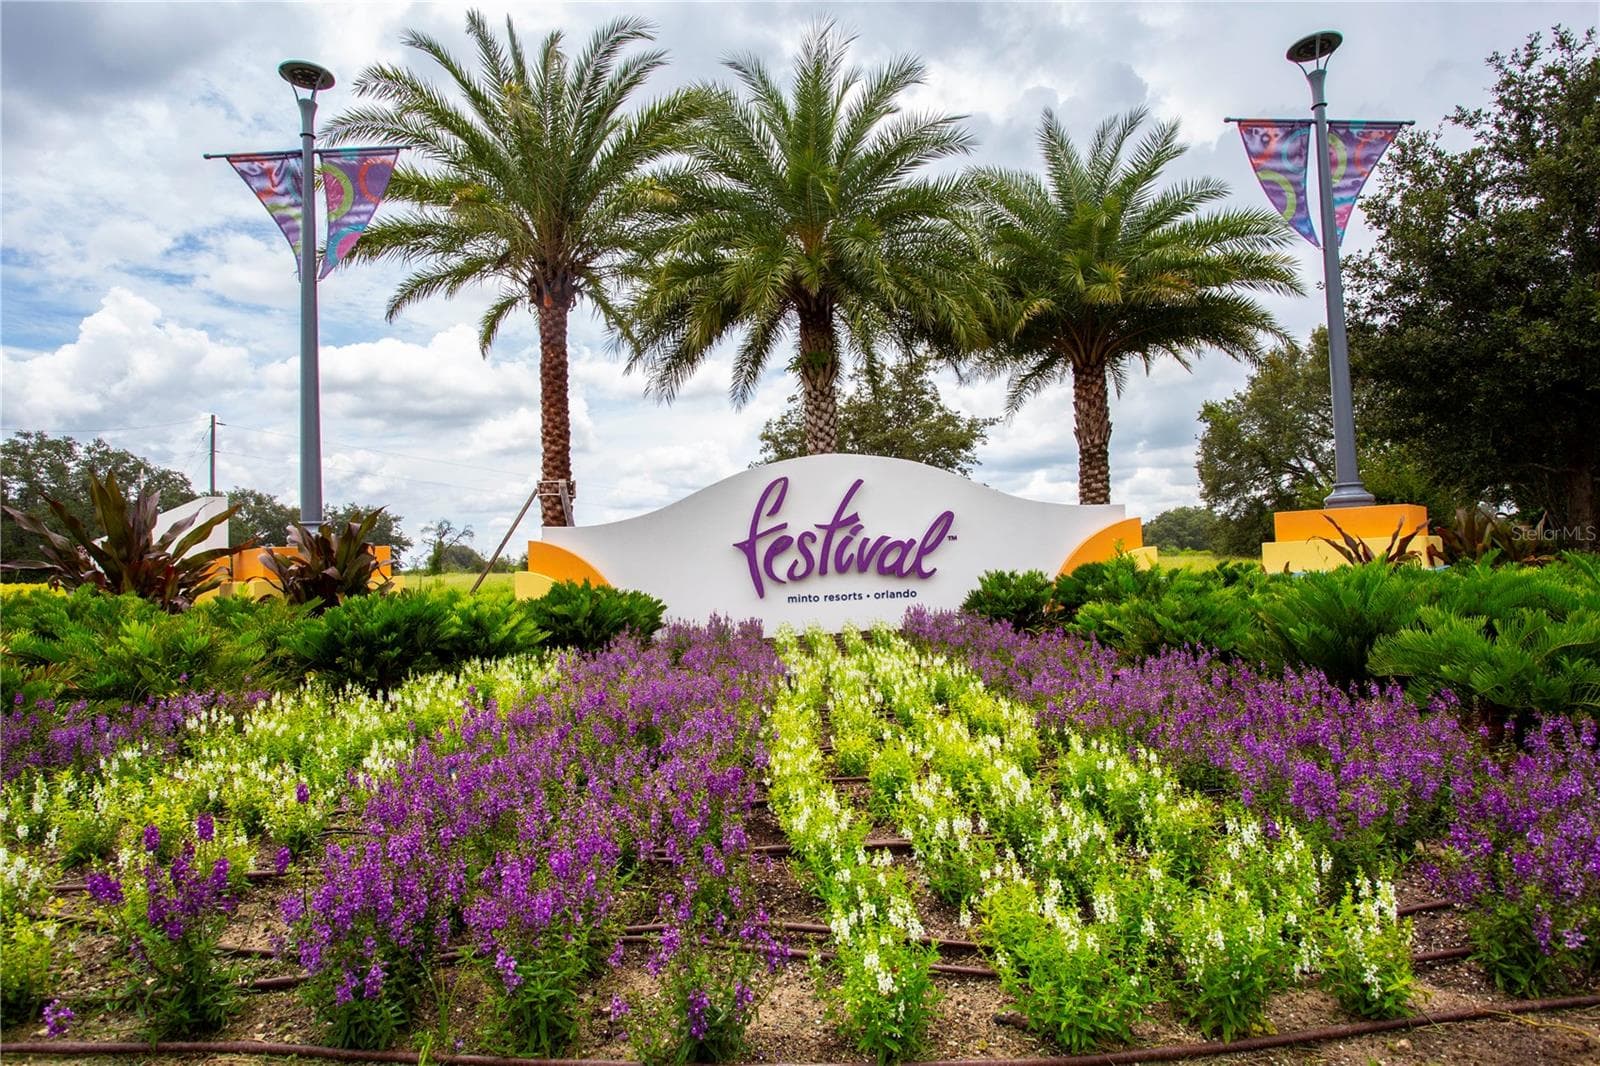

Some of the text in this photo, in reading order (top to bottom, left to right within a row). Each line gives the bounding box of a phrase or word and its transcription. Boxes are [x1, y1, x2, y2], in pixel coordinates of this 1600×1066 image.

[733, 476, 954, 599] festival
[787, 588, 918, 603] minto resorts orlando
